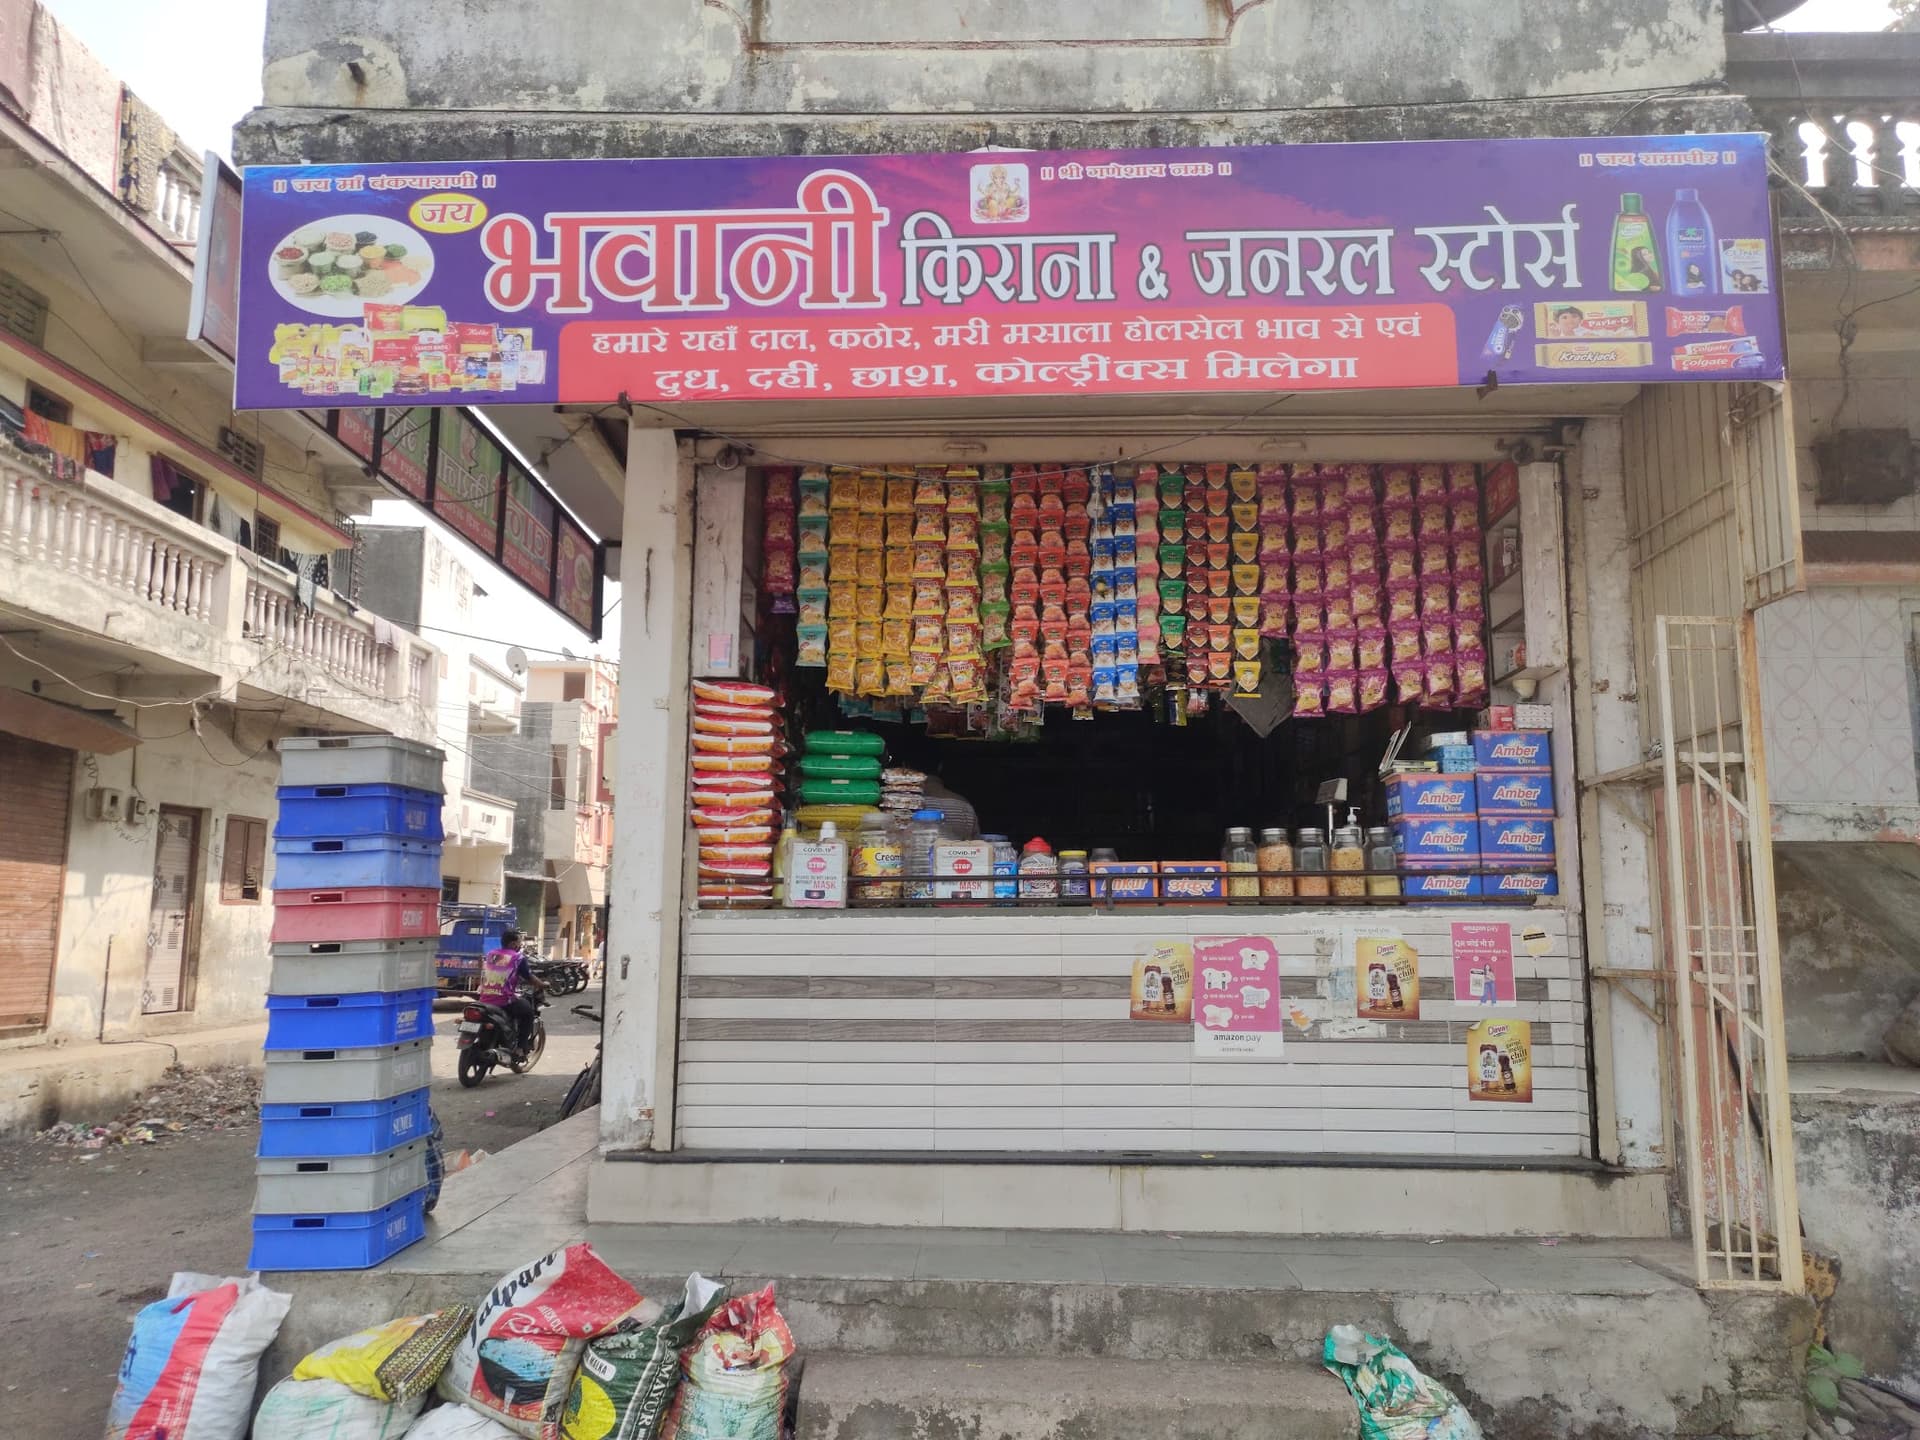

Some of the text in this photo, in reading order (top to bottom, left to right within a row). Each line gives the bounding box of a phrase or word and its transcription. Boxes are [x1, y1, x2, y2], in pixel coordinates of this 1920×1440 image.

[1596, 153, 1635, 166] जय
[1639, 148, 1718, 166] रामापीर
[1058, 162, 1082, 179] श्री
[1086, 163, 1165, 178] गणेशाय
[293, 178, 331, 193] जय
[420, 202, 476, 223] जय
[480, 169, 1582, 313] भवानी किराना & जनरल स्टोर्स
[592, 312, 1422, 354] हमारे यहाँ दाल, कठोर, मरी मसाला होलसेल भाव से एवं
[1559, 351, 1617, 362] Krackjack
[1681, 357, 1729, 367] Colgate
[653, 369, 730, 396] दुध,
[850, 365, 957, 388] छाश,
[1204, 350, 1359, 380] मिलेगा
[1491, 744, 1539, 758] Amber
[1417, 791, 1465, 805] Amber
[1493, 786, 1541, 800] Amber
[1420, 831, 1468, 845] Amber
[1497, 830, 1545, 845] Amber
[813, 880, 836, 890] MASK
[959, 880, 982, 890] MASK
[1422, 876, 1470, 890] Amber
[1499, 874, 1548, 889] Amber
[1246, 1034, 1261, 1042] pay
